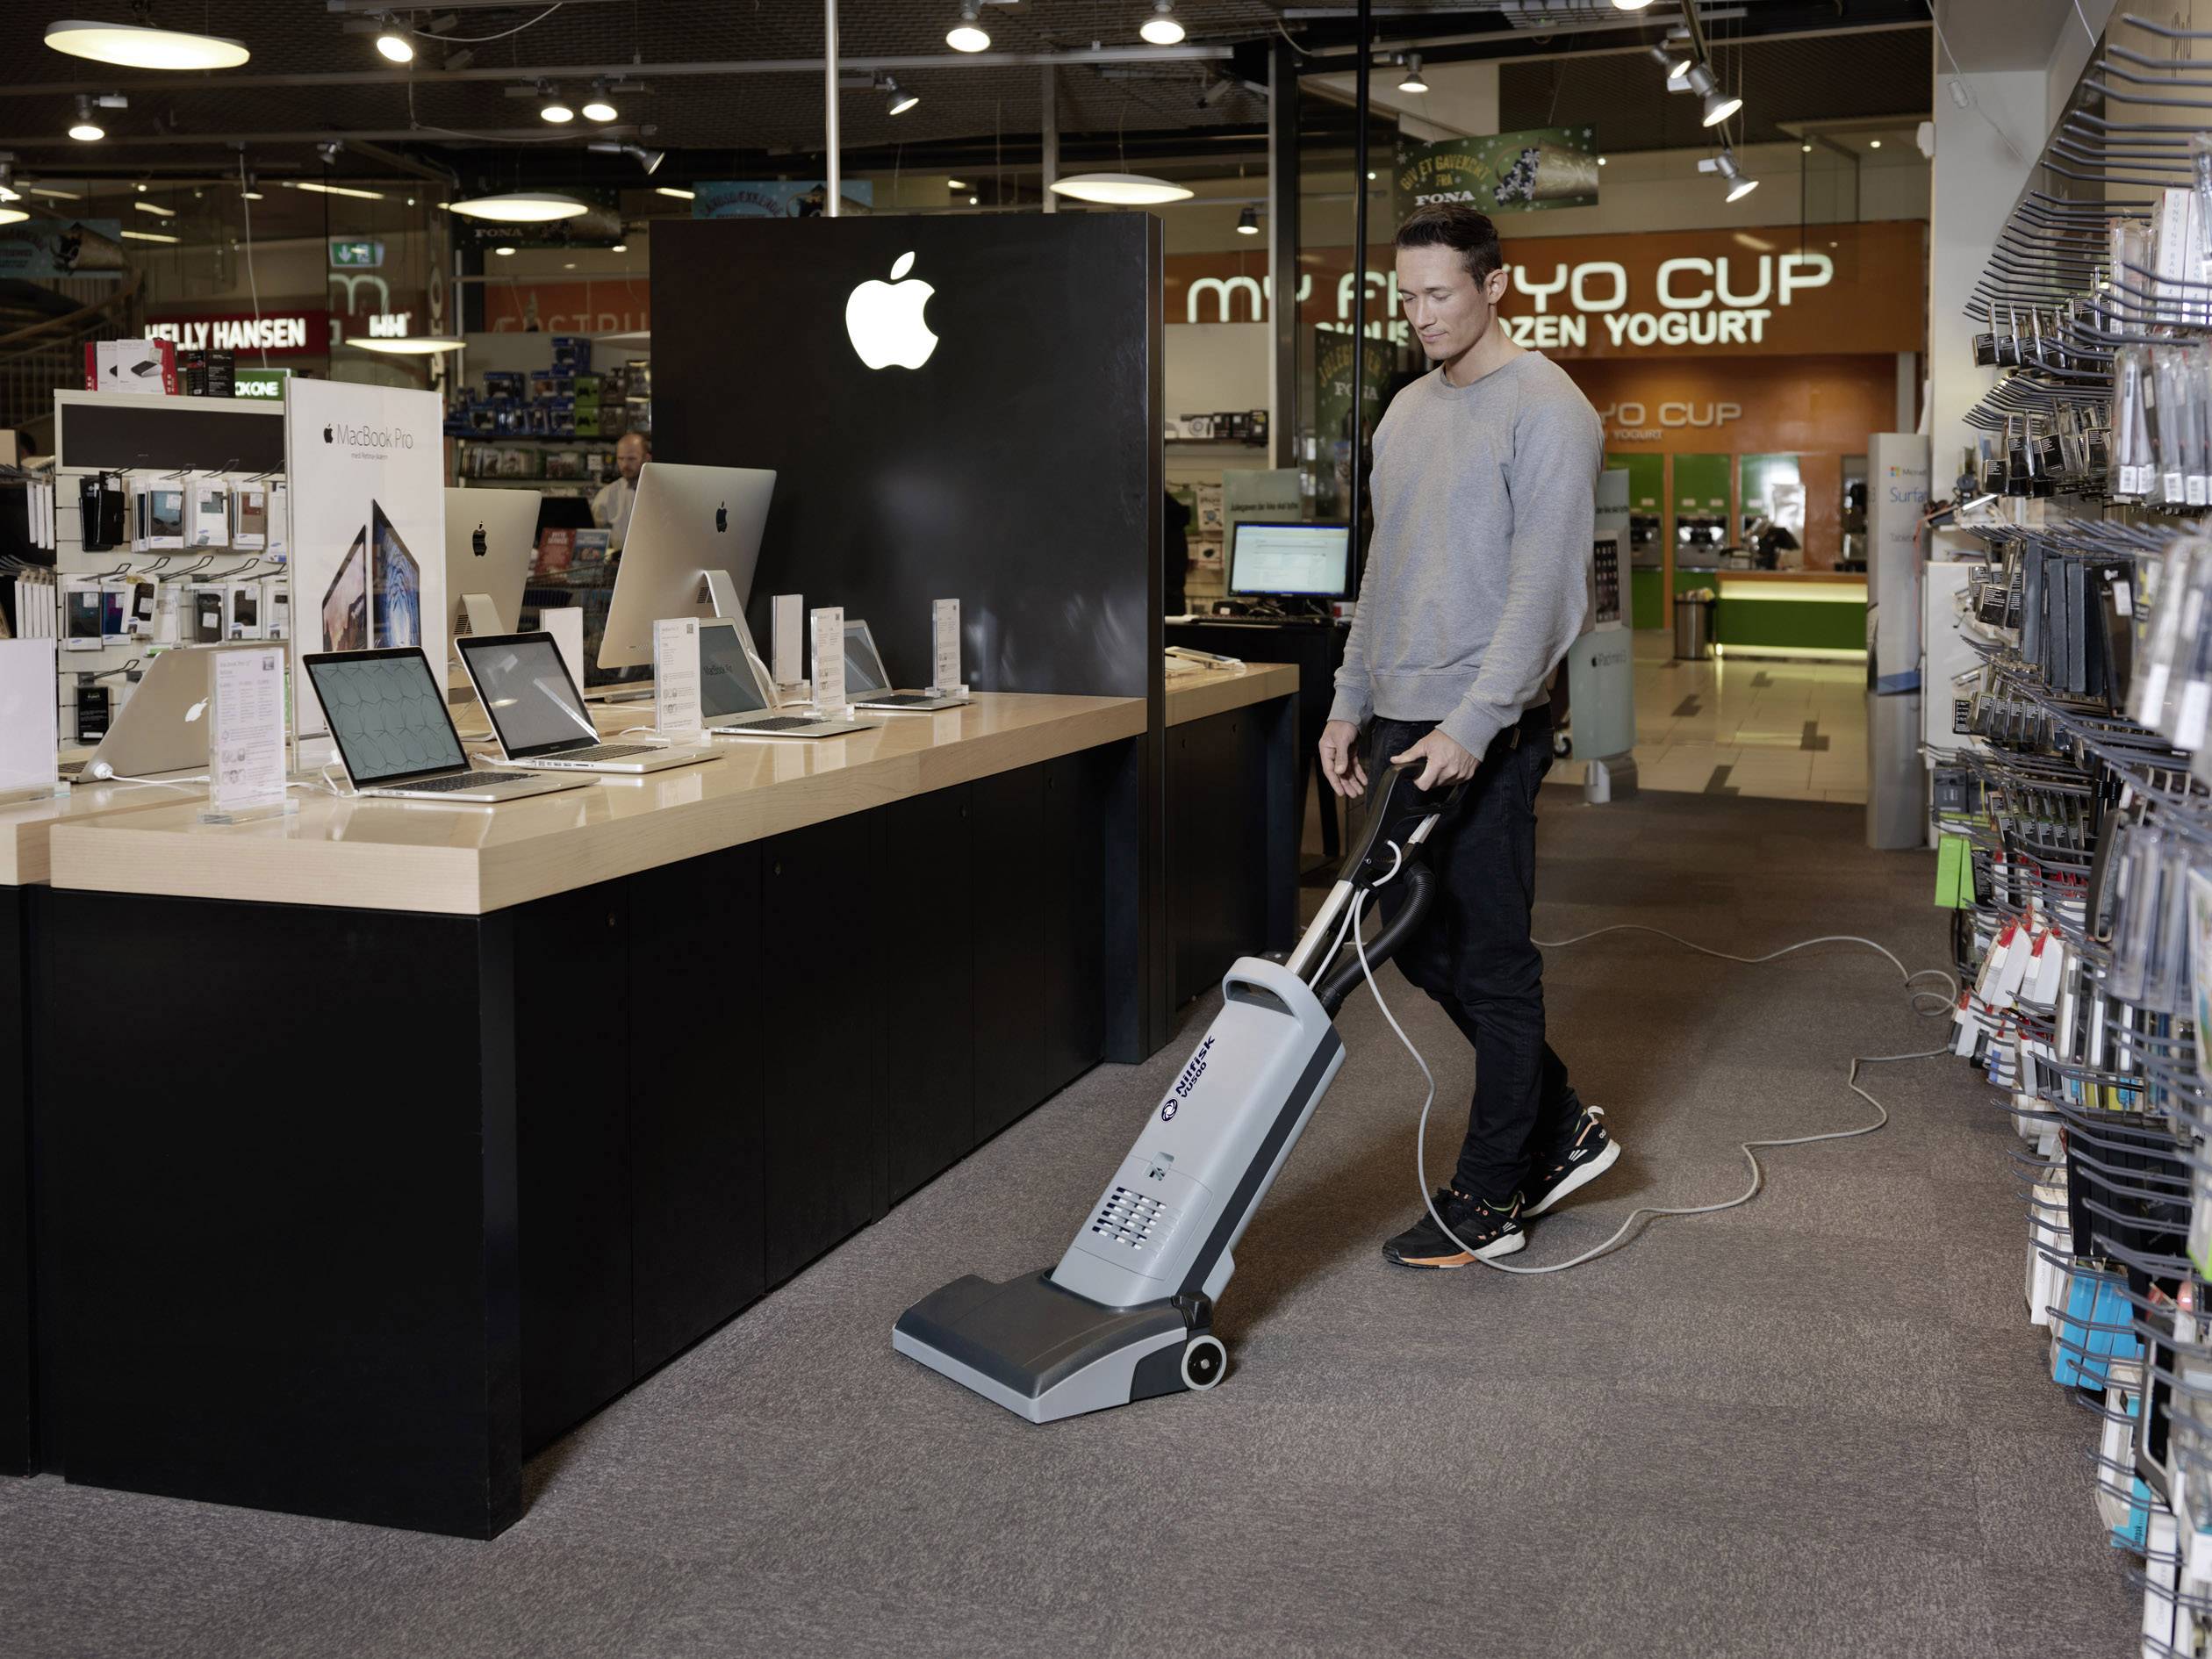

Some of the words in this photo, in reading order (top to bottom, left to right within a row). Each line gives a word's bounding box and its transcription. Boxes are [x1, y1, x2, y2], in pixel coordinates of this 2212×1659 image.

[1418, 158, 1433, 176] ET
[1436, 173, 1454, 186] FRA
[1415, 190, 1476, 206] FONA
[475, 227, 524, 238] FONA
[1656, 254, 1834, 309] CUP
[213, 317, 306, 350] HANSEN
[1604, 310, 1771, 347] YOGURT
[251, 381, 279, 396] ONE
[1658, 401, 1742, 427] CUP
[337, 424, 392, 448] MacBook
[395, 427, 413, 449] Pro
[1175, 1035, 1215, 1095] Nilfisk
[1181, 1061, 1207, 1098] VU500
